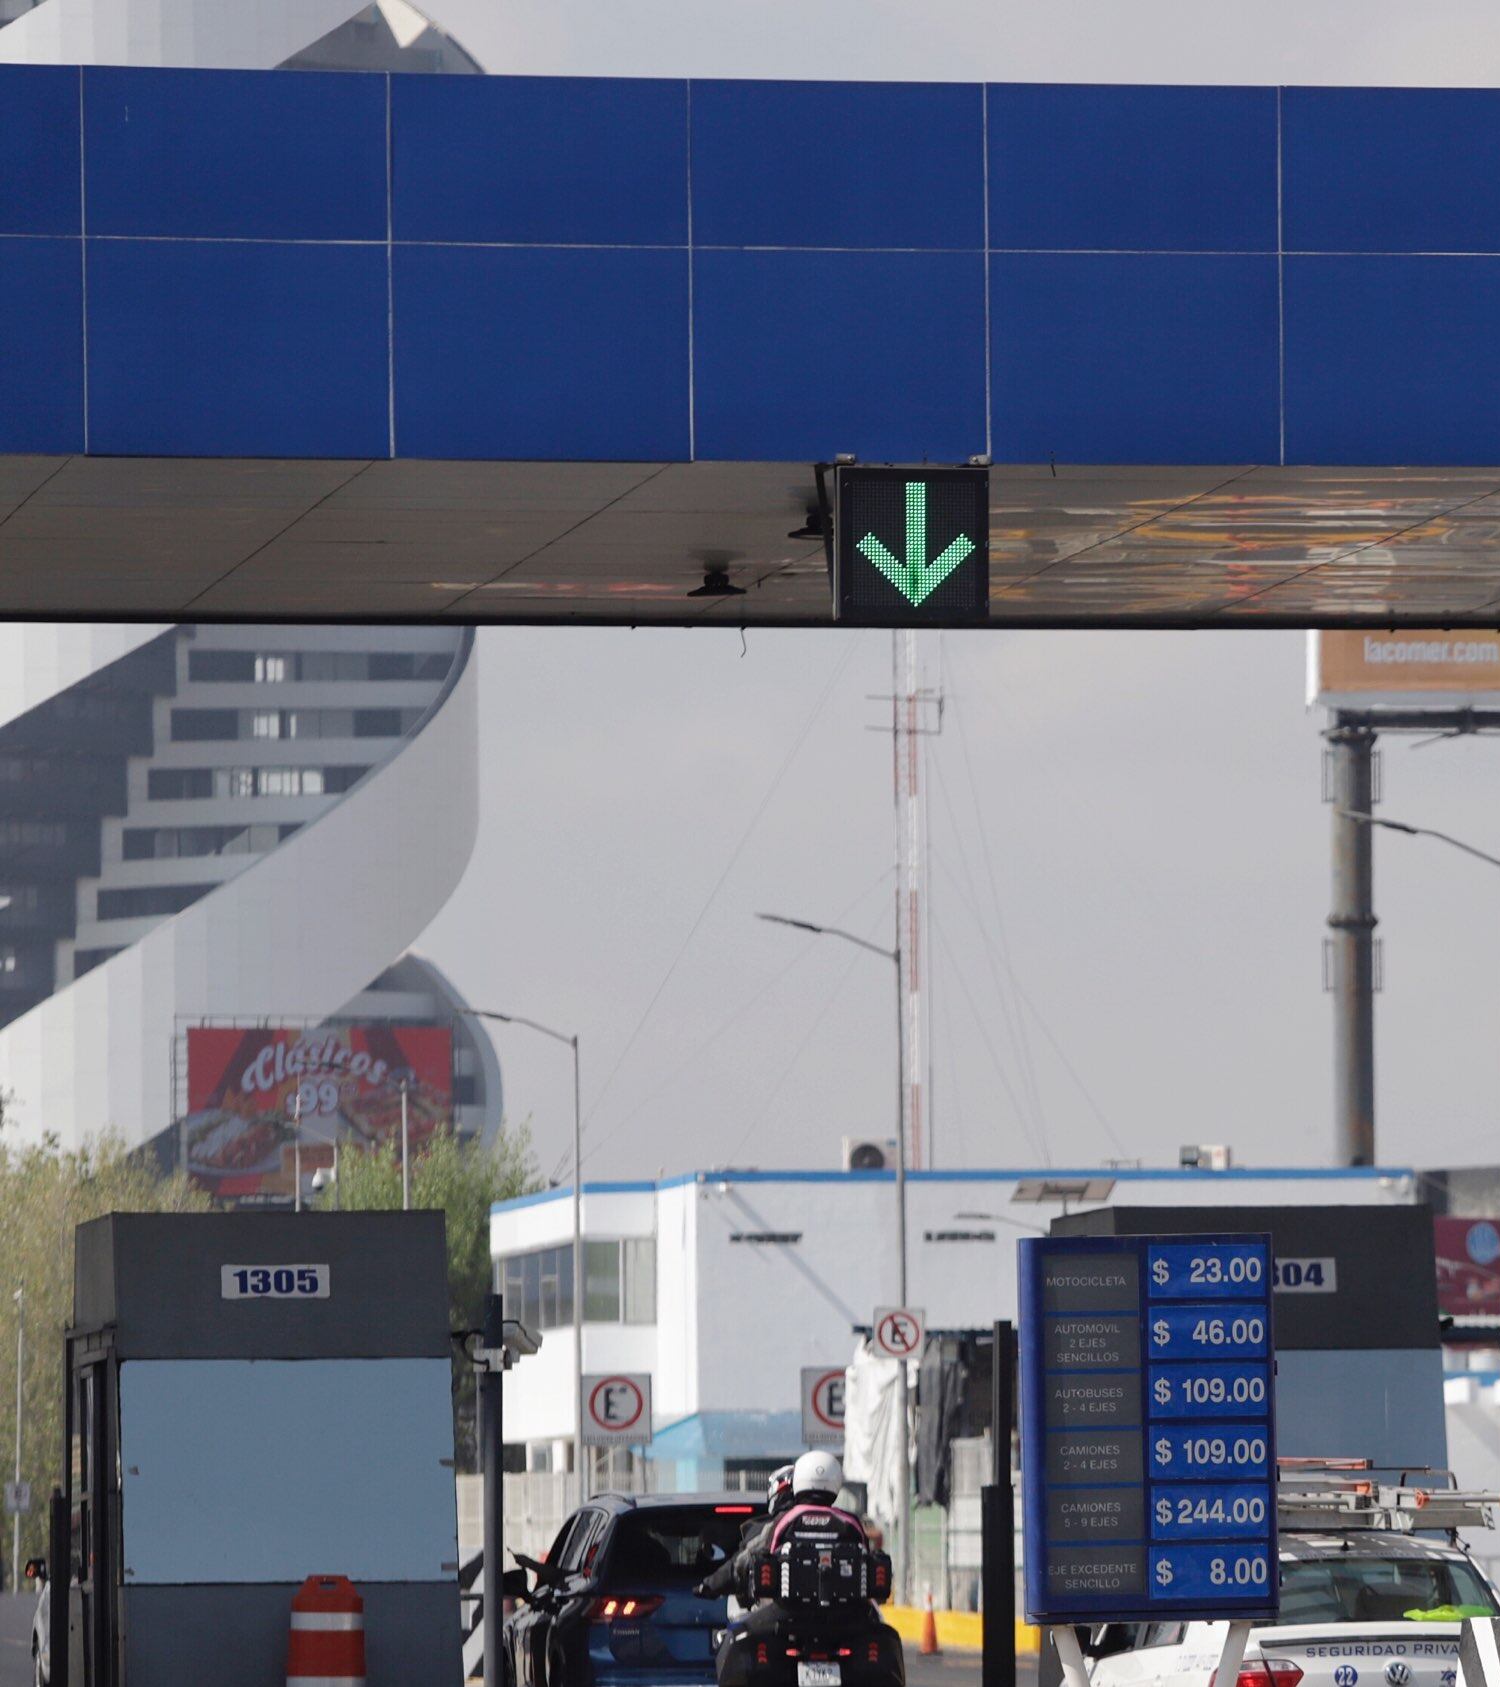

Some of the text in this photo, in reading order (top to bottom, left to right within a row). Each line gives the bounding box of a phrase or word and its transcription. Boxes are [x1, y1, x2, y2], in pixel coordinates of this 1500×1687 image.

[1364, 636, 1500, 663] lacomer.com
[1190, 1257, 1262, 1284] 23.00
[233, 1269, 318, 1294] 1305
[1046, 1276, 1127, 1287] MOTOCICLETA
[1192, 1318, 1264, 1345] 46.00
[1070, 1338, 1107, 1348] 2 EJES
[1056, 1352, 1120, 1364] SENCILLOS
[1054, 1388, 1124, 1399] AUTOBUSES
[1182, 1377, 1265, 1403] 109.00
[1063, 1403, 1069, 1412] 2
[1080, 1403, 1086, 1412] 4
[1089, 1402, 1116, 1412] EJES
[1060, 1445, 1120, 1456] CAMIONES
[1183, 1438, 1266, 1464] 109.00
[1064, 1460, 1070, 1470] 2
[1080, 1460, 1086, 1470] 4
[1090, 1460, 1118, 1470] EJES
[1061, 1502, 1122, 1513] CAMIONES
[1064, 1518, 1070, 1527] 5
[1081, 1518, 1087, 1527] 9
[1090, 1517, 1118, 1527] EJES
[1048, 1564, 1137, 1576] EJE EXCEDENTE
[1210, 1558, 1267, 1585] 8.00
[1064, 1578, 1120, 1589] SENCILLO
[1306, 1644, 1406, 1658] SEGURIDAD
[1338, 1667, 1353, 1686] 22
